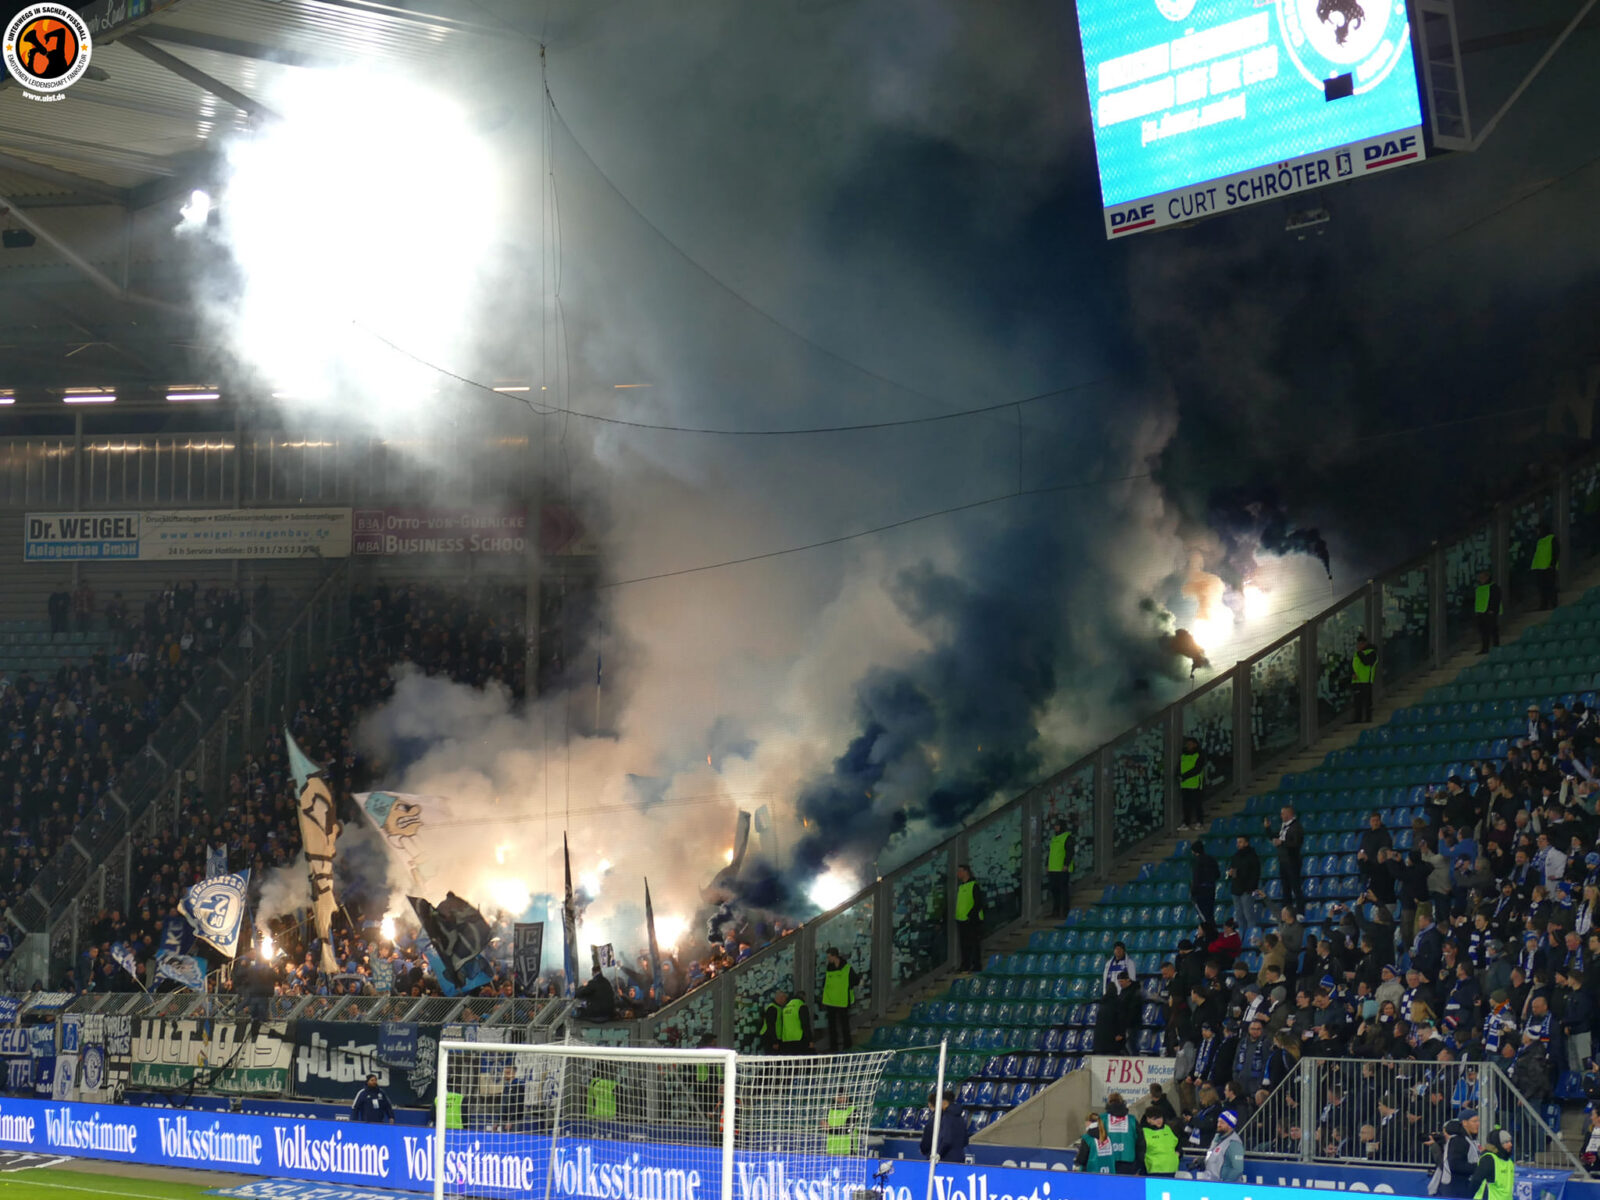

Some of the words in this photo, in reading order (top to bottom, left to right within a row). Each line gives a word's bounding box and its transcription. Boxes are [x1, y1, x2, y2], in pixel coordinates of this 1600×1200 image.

[1364, 136, 1417, 162] DAF
[1168, 188, 1216, 221] CURT
[1225, 157, 1331, 206] SCHRÖTER
[1111, 204, 1155, 227] DAF
[28, 543, 99, 558] Anlagenbau
[102, 542, 137, 556] GmbH
[30, 519, 56, 539] Dr.
[59, 518, 137, 539] WEIGEL
[470, 533, 528, 552] SCHOO
[137, 1018, 289, 1068] ULTRAS
[296, 1031, 391, 1087] HUGOS
[1105, 1058, 1144, 1084] FBS
[44, 1108, 138, 1154] Volksstimme
[158, 1116, 262, 1166] Volksstimme
[274, 1124, 390, 1178] Volksstimme
[552, 1146, 701, 1200] Volksstimme
